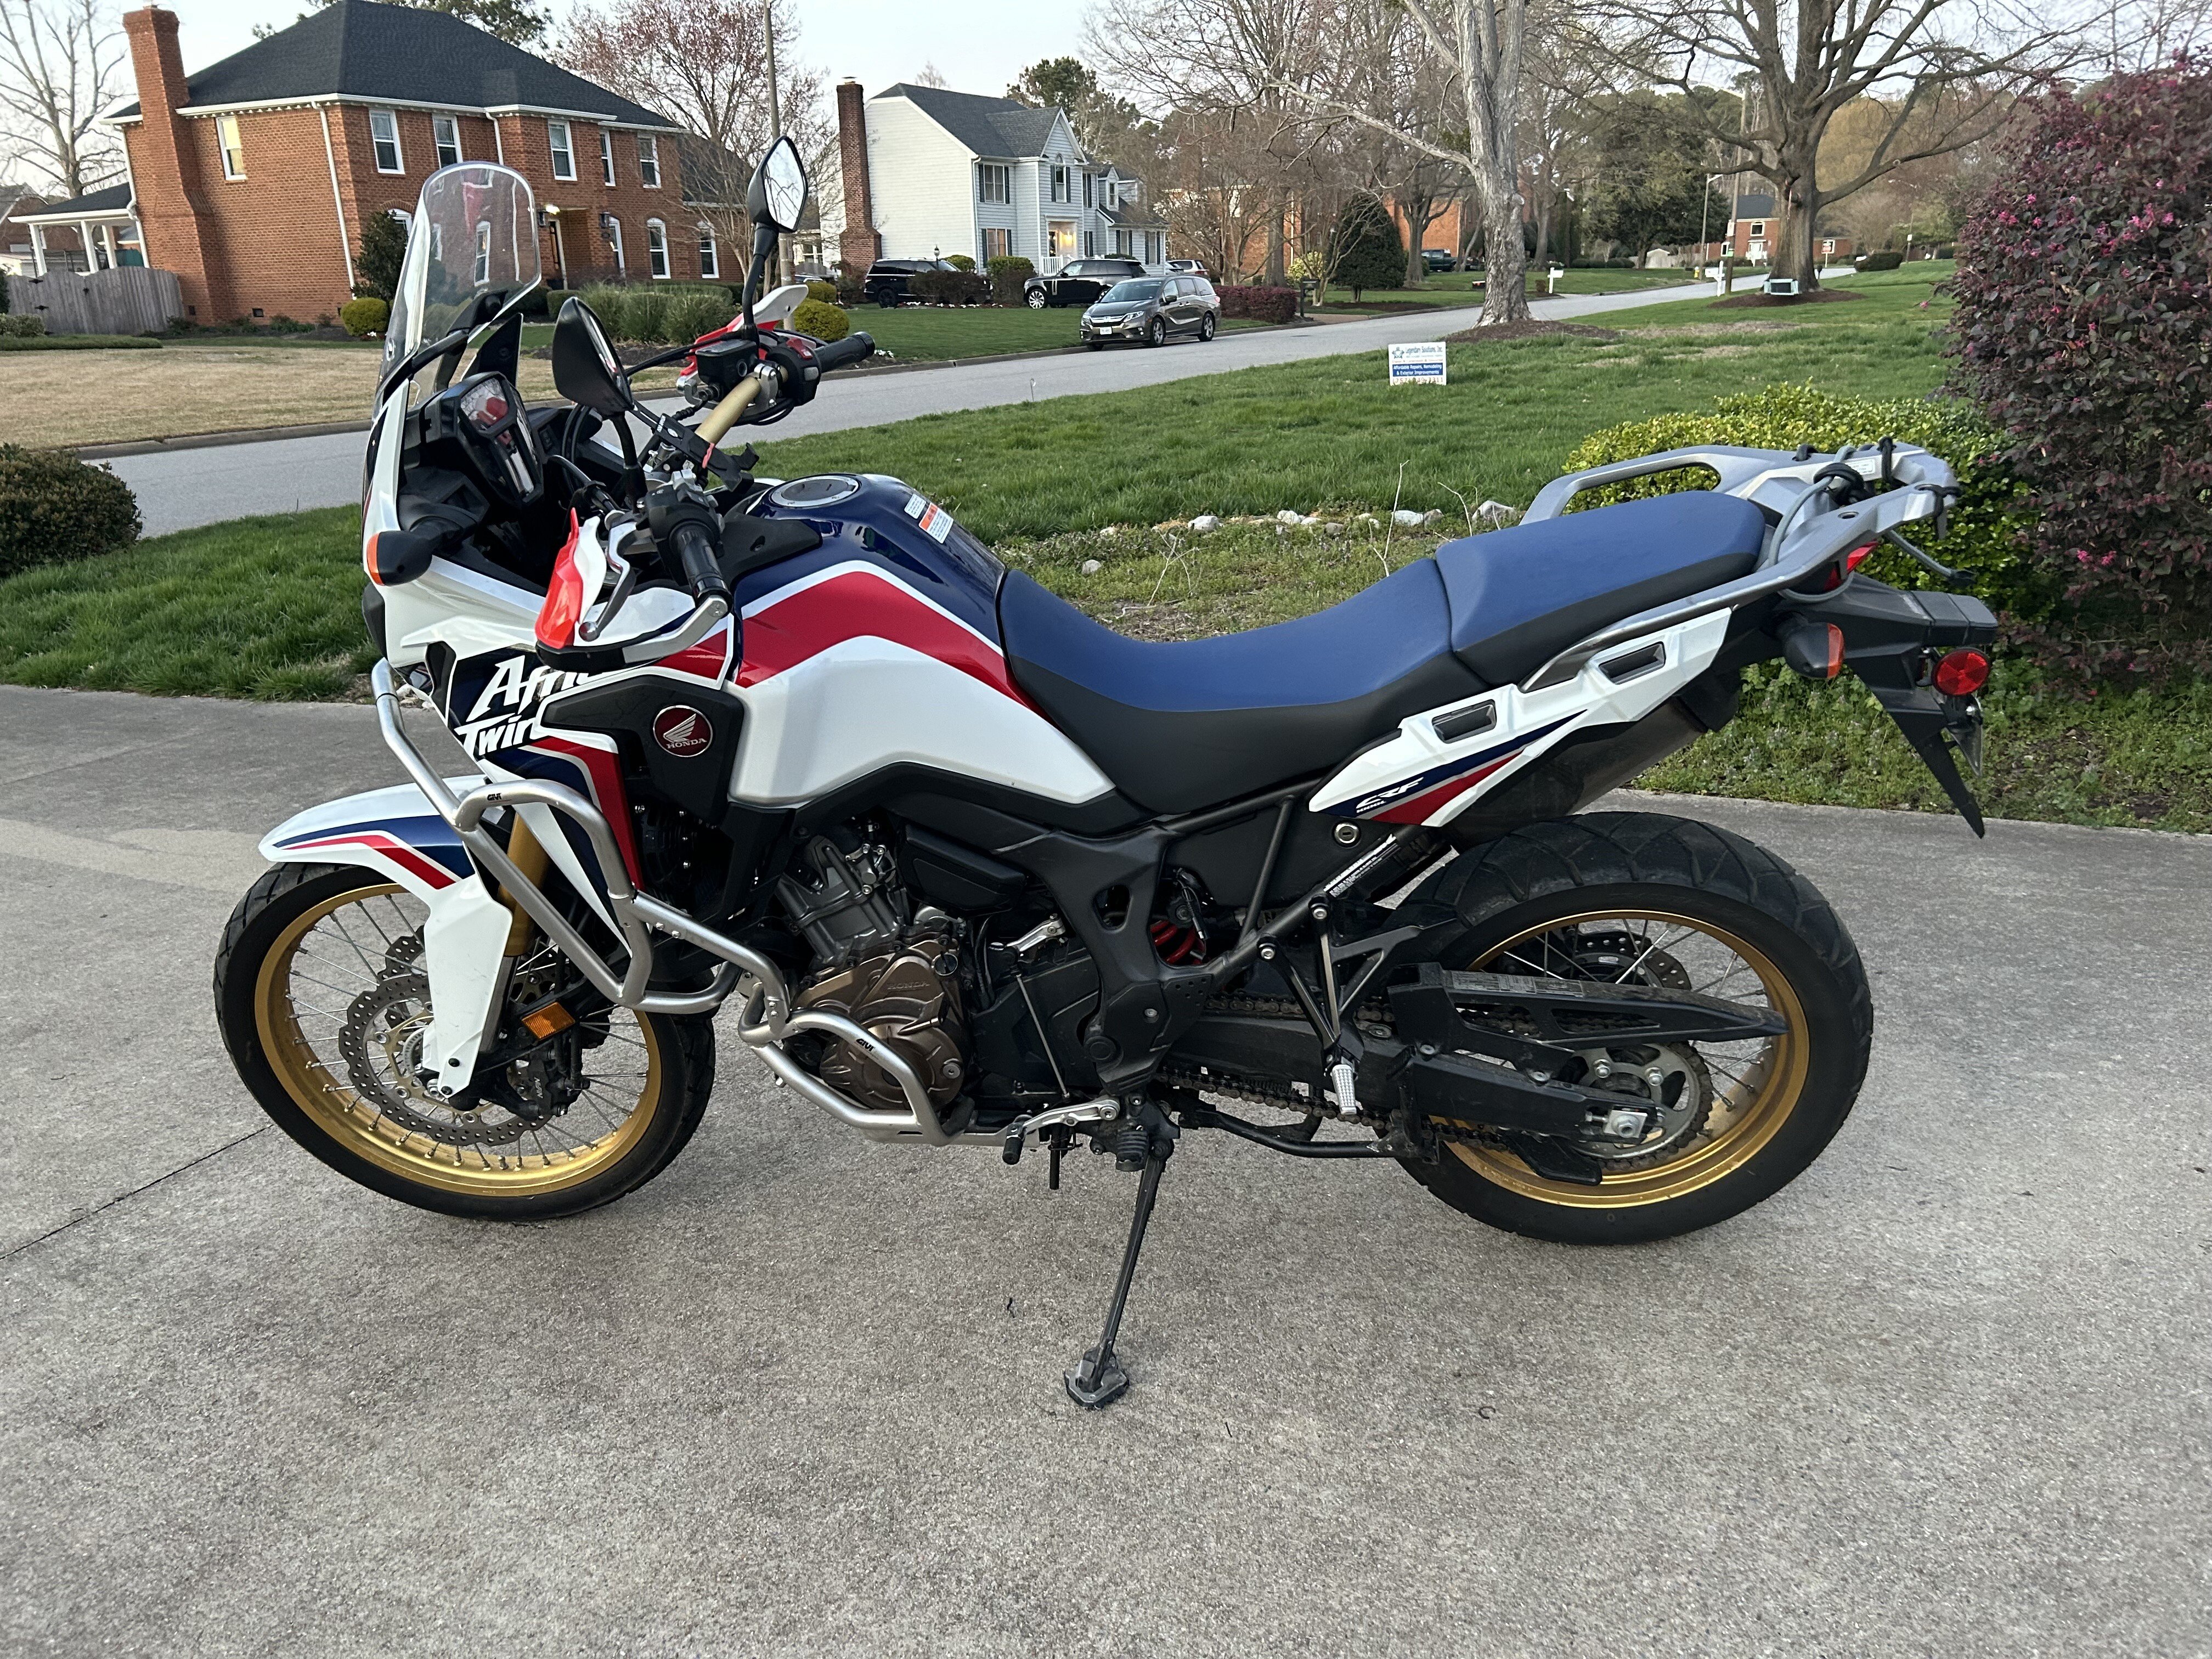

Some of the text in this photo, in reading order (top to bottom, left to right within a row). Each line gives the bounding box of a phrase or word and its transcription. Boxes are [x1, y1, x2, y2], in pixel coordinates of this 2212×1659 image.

[454, 713, 538, 761] Twin
[666, 738, 707, 749] HONDA
[487, 793, 502, 801] GIVI
[1356, 776, 1424, 809] CRF
[887, 980, 930, 990] HONDA
[856, 1038, 875, 1052] GIVI
